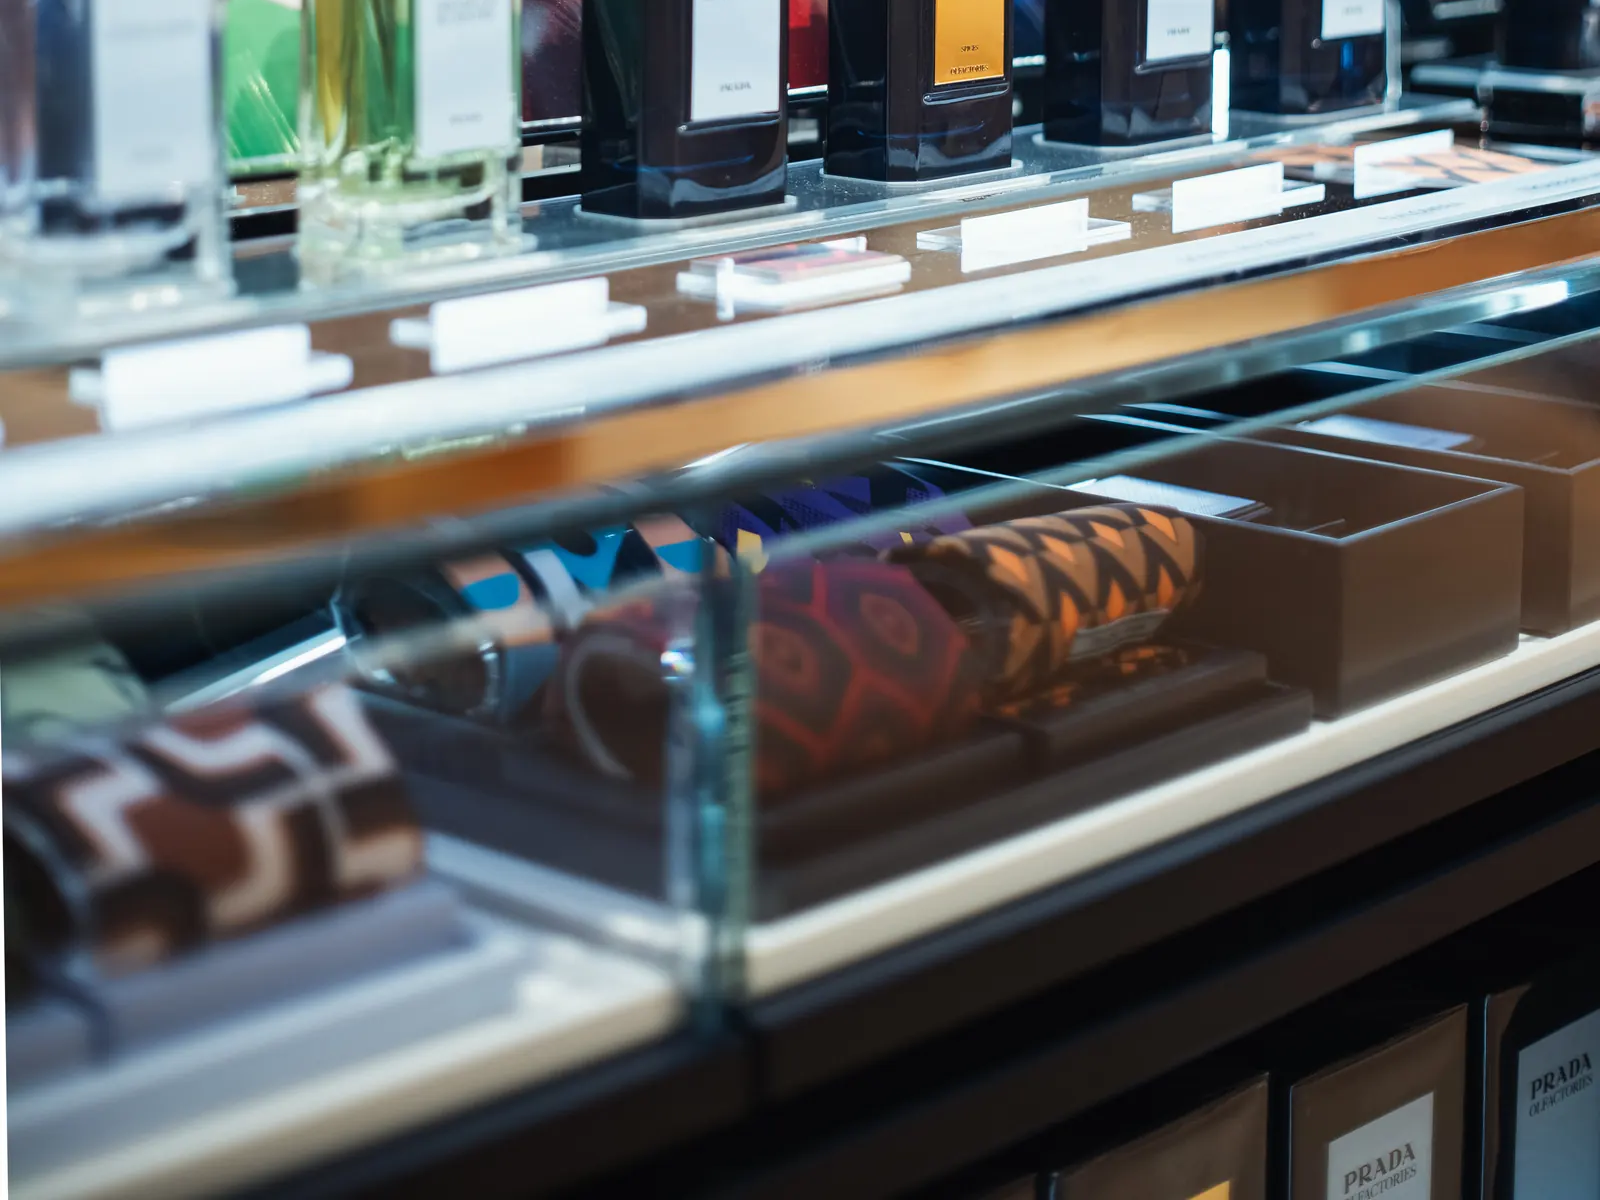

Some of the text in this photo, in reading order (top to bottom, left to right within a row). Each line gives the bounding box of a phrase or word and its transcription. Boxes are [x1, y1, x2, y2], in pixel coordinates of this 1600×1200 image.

[1529, 1073, 1593, 1117] OLFACTORIES
[1531, 1052, 1592, 1100] PRADA
[1343, 1142, 1416, 1195] PRADA
[1344, 1164, 1418, 1200] FACTORIES
